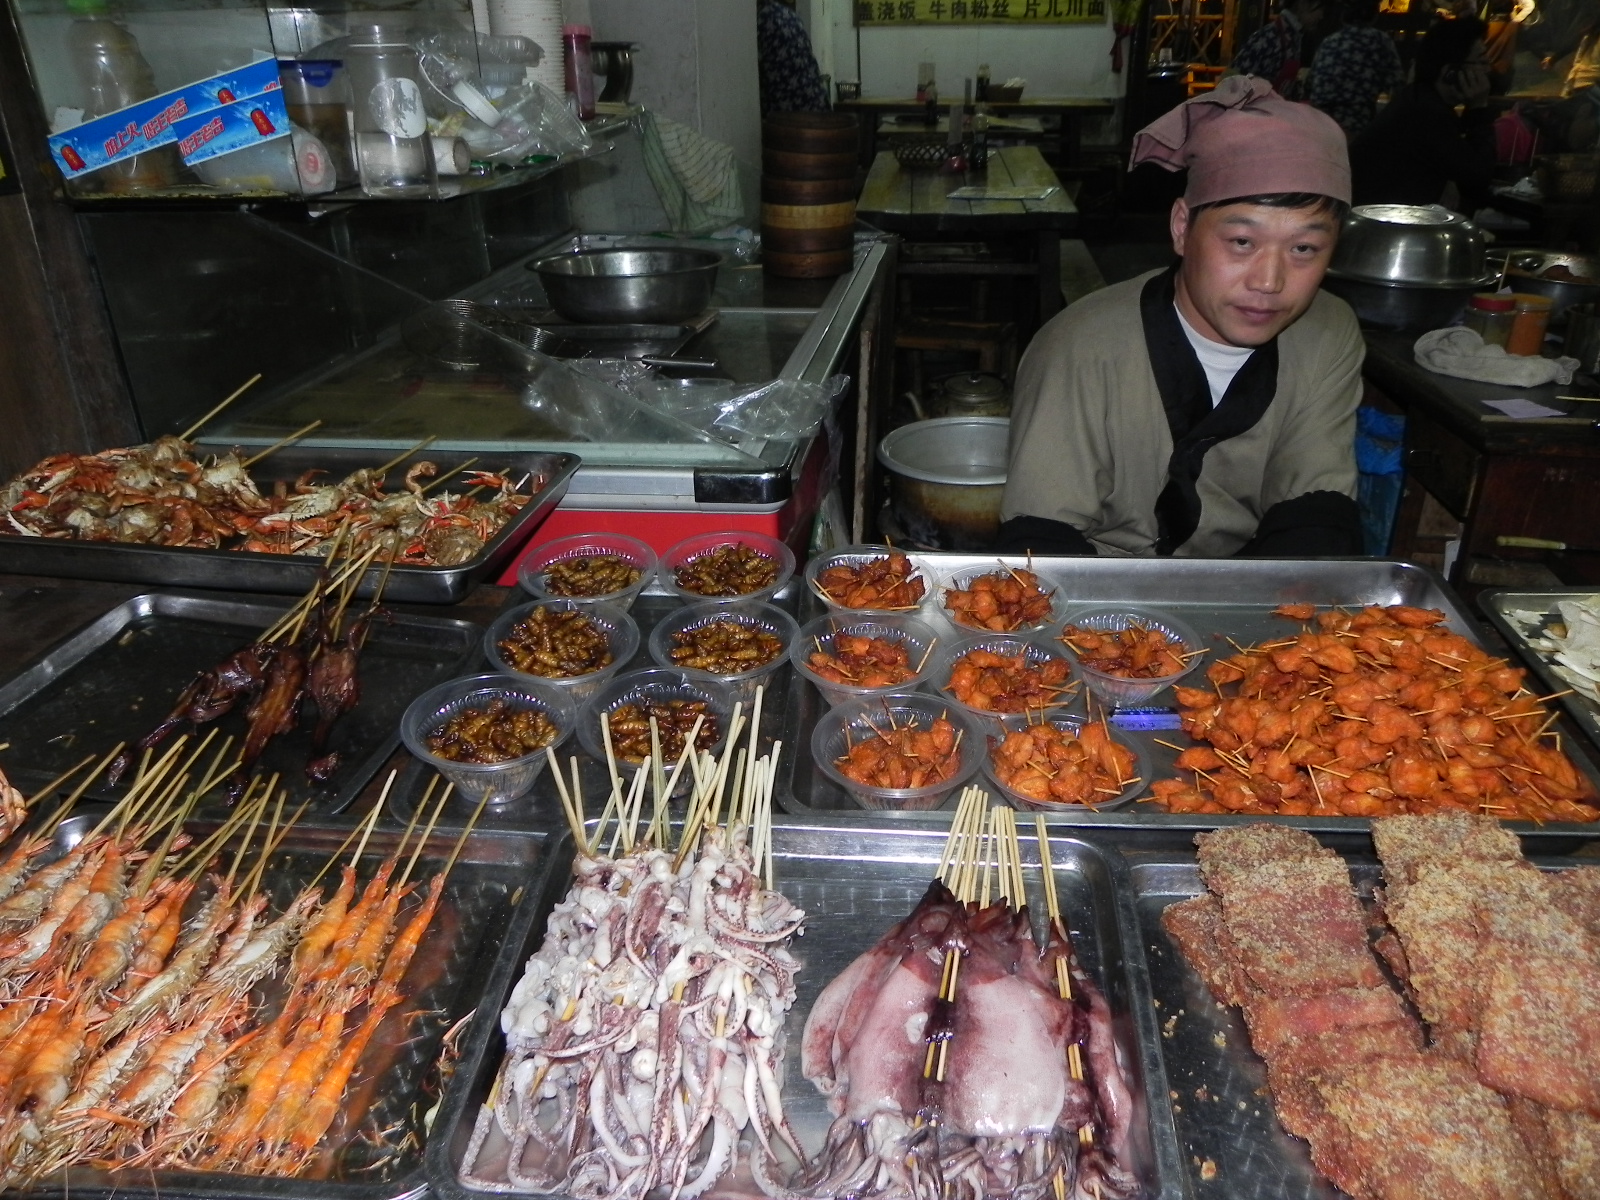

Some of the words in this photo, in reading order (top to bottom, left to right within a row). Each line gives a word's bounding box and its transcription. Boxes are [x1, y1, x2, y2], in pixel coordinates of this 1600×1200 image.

[929, 0, 1010, 19] 牛肉粉丝
[1023, 0, 1104, 18] 片儿川面
[104, 121, 142, 158] 怕上火
[142, 97, 189, 140] 喝王老吉
[178, 116, 226, 157] 喝王老吉
